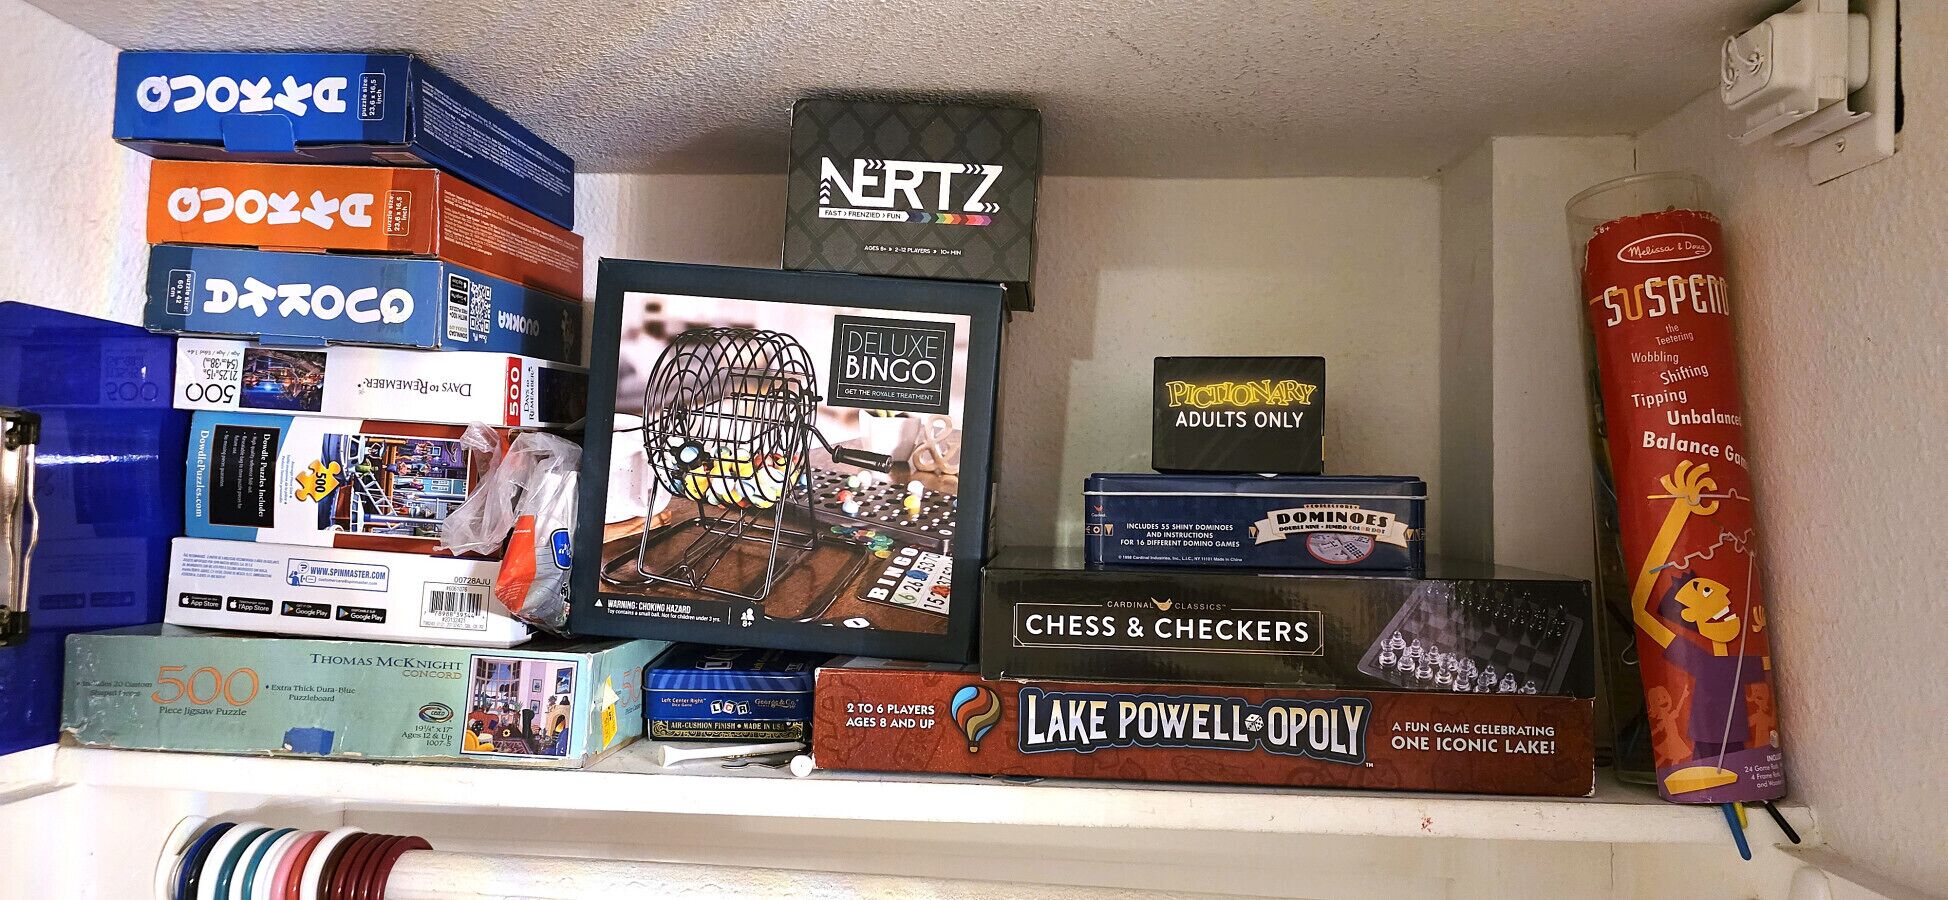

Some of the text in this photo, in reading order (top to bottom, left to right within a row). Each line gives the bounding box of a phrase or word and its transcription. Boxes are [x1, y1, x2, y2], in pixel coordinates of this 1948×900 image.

[137, 75, 347, 117] QUOKKA
[819, 156, 1003, 213] NERTZ
[168, 187, 374, 230] QUOKKA
[1628, 245, 1674, 258] Melissa
[1685, 241, 1706, 254] Doug
[171, 286, 175, 297] cm
[177, 280, 183, 289] 60
[176, 295, 182, 303] 42
[204, 276, 414, 324] QUOKKA
[498, 310, 539, 336] QUOKKA
[1666, 324, 1679, 333] the
[848, 331, 938, 359] DELUXE
[1655, 332, 1694, 346] Teetering
[1631, 351, 1679, 365] Wobbling
[846, 355, 936, 384] BINGO
[1660, 365, 1709, 385] Shifting
[186, 383, 236, 403] 500
[430, 384, 439, 392] to
[442, 383, 472, 397] DAYS
[509, 366, 520, 416] 500
[896, 392, 934, 400] TREATMENT
[1166, 380, 1317, 408] PICTIONARY
[1631, 390, 1687, 408] Tipping
[1175, 411, 1304, 428] ADULTS ONLY
[260, 434, 271, 460] Dowdle
[1643, 431, 1719, 457] Balance
[196, 430, 210, 517] DowdlePuzzles.com
[259, 462, 267, 487] Puzzles
[315, 472, 326, 493] 500
[1276, 511, 1388, 527] DOMINOES
[1215, 540, 1240, 548] GAMES
[310, 566, 385, 580] WWW.SPINMASTER.COM
[454, 576, 491, 586] 00728AJU
[867, 547, 918, 600] BINGO
[904, 581, 924, 592] 26
[296, 608, 315, 616] Google
[608, 599, 691, 614] WARNING: CHOKING HAZARD
[1107, 601, 1154, 609] CARDINAL
[350, 613, 383, 622] Google Play
[742, 620, 752, 628] 8+
[1026, 614, 1308, 642] CHESS & CHECKERS
[310, 653, 463, 670] THOMAS McKNIGHT
[402, 669, 462, 679] CONCORD
[151, 665, 259, 706] 500
[271, 684, 292, 692] Extra
[316, 686, 355, 694] Dura-Blue
[288, 694, 335, 702] Puzzleboard
[159, 706, 247, 716] Piece Jigsaw Puzzle
[847, 703, 935, 715] 2 TO 6 PLAYERS
[846, 717, 935, 729] AGES 8 AND UP
[1027, 695, 1364, 756] LAKE POWELL OPOLY
[1392, 722, 1554, 737] A FUN GAME CELEBRATING
[1392, 736, 1555, 754] ONE ICONIC LAKE!
